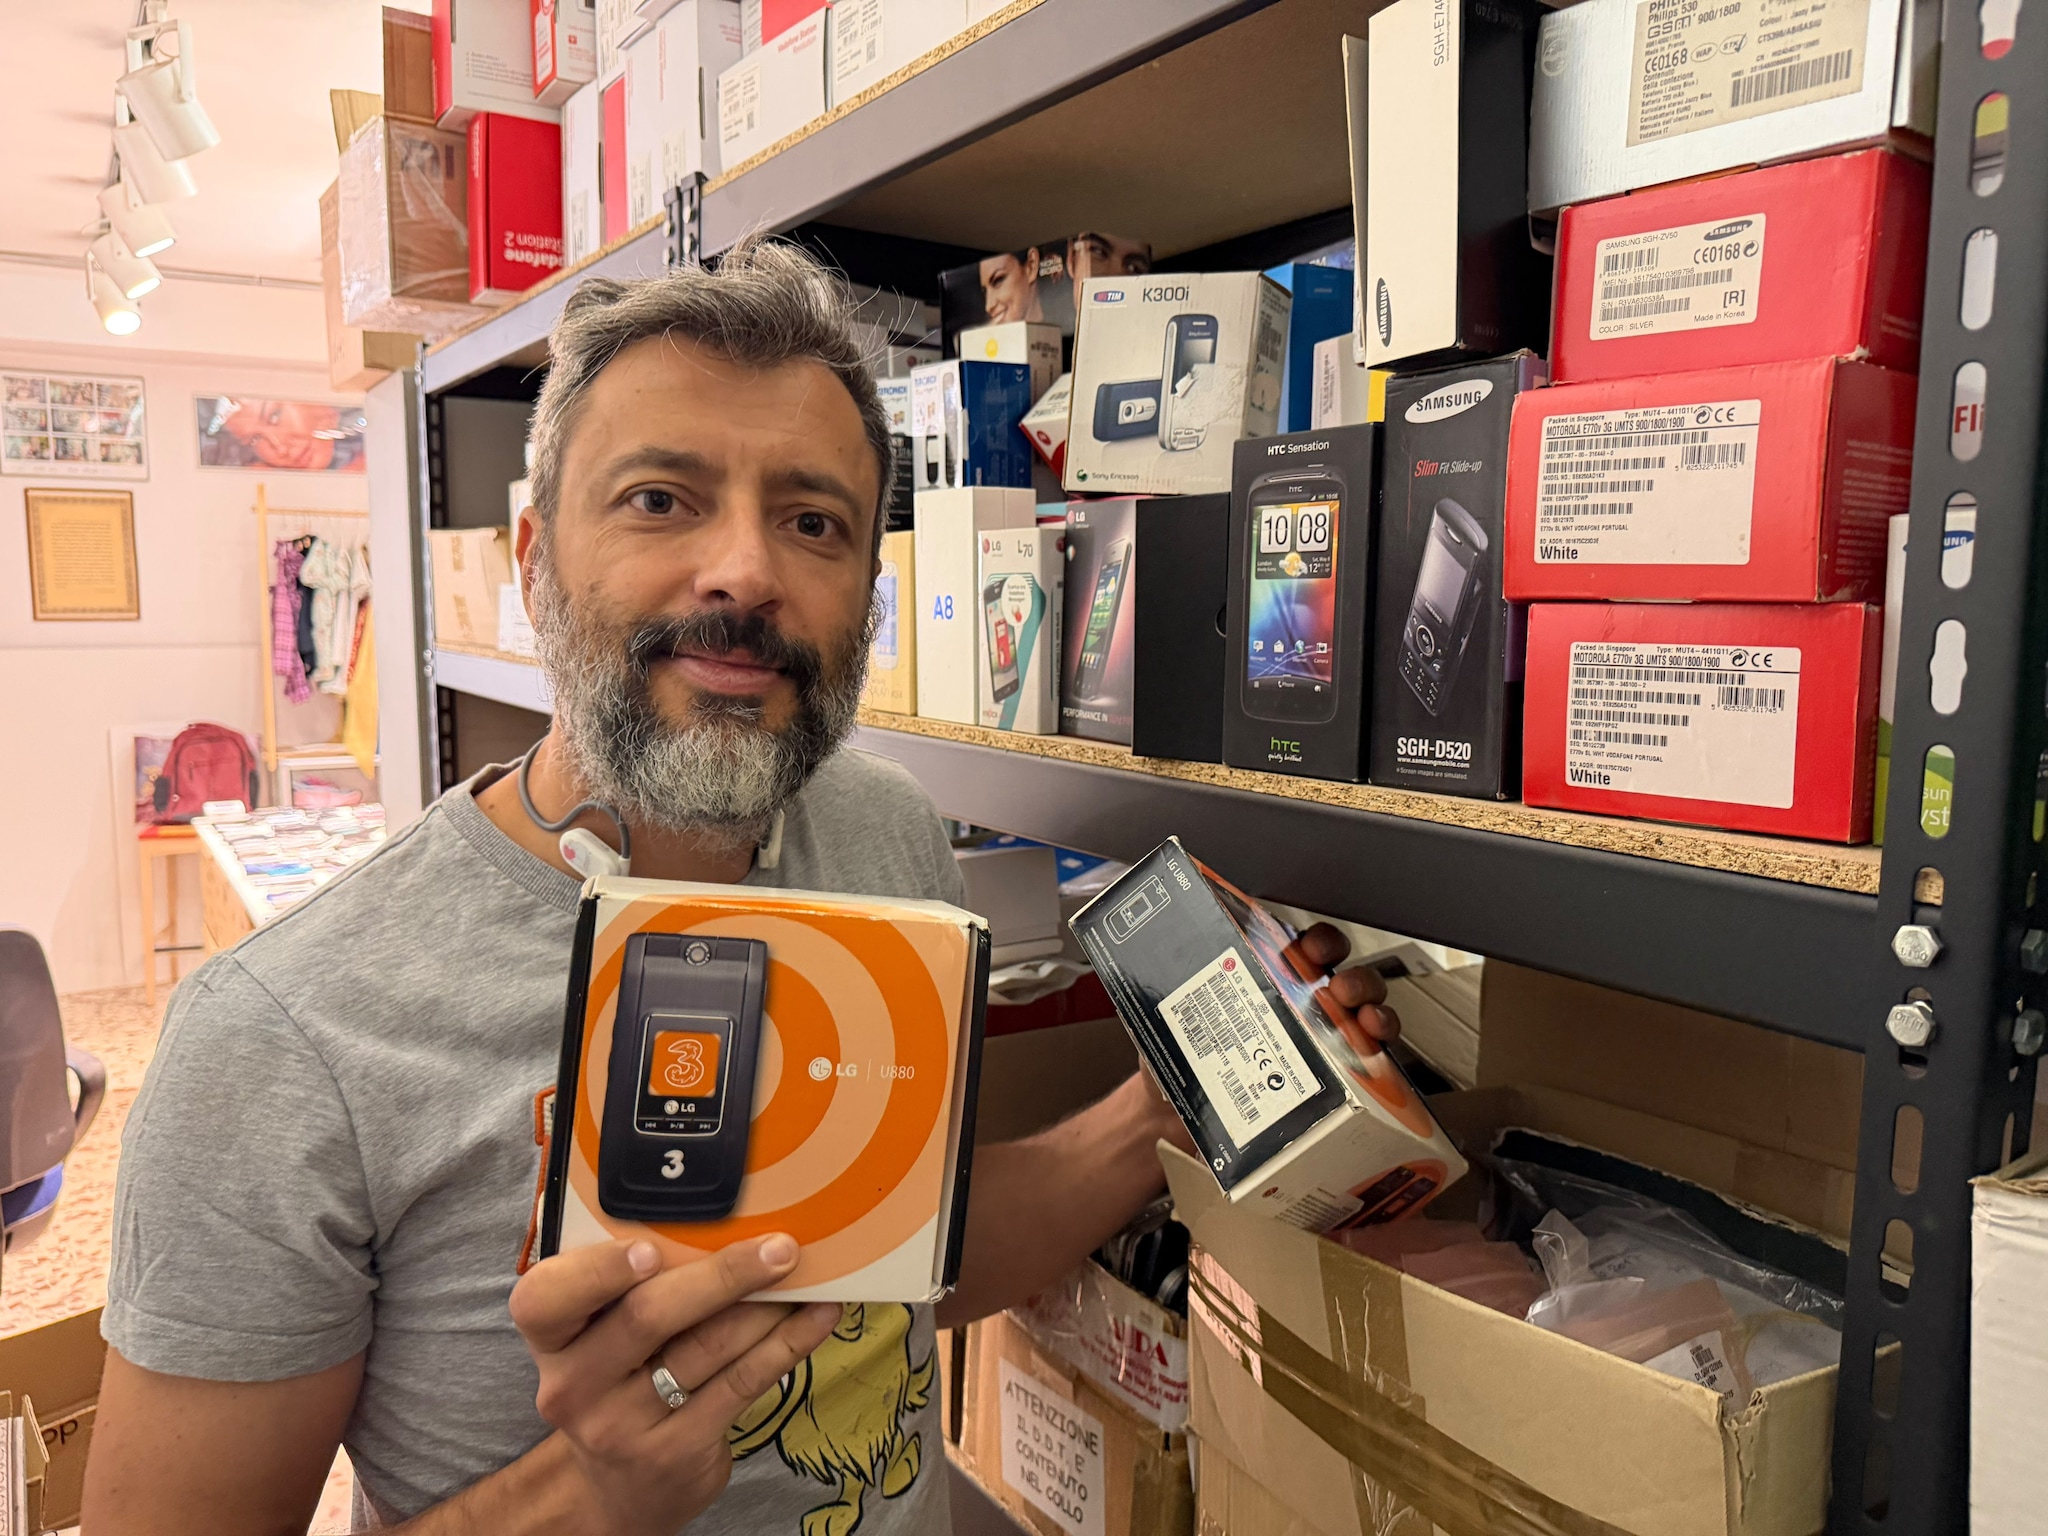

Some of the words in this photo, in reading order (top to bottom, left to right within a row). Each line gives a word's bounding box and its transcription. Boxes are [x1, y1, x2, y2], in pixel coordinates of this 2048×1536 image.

[1648, 7, 1678, 24] Philips
[1680, 0, 1697, 14] 530
[1697, 2, 1740, 24] 900/1800
[1695, 46, 1712, 58] WAP
[1642, 79, 1658, 90] della
[1660, 70, 1693, 86] confezione
[1643, 67, 1674, 82] Contenuto
[1709, 224, 1748, 236] SAMSUNG
[504, 231, 515, 247] 2
[1605, 237, 1640, 249] SAMSUNG
[1642, 231, 1677, 243] SGH-ZV50
[503, 248, 565, 270] odafone
[1107, 292, 1123, 300] TIM
[1142, 286, 1191, 303] K300i
[1693, 313, 1713, 321] Made
[1724, 310, 1744, 318] Korea
[1598, 324, 1623, 333] COLOR
[1629, 320, 1653, 329] SILVER
[1416, 391, 1482, 412] SAMSUNG
[1576, 414, 1604, 423] Singapore
[1624, 411, 1640, 419] Type:
[1546, 424, 1580, 436] MOTOROLA
[1583, 422, 1601, 433] E770v
[1602, 422, 1612, 432] 3G
[1614, 420, 1634, 431] UMTS
[1635, 416, 1685, 430] 900/1800/1900
[1267, 444, 1286, 456] HTC
[1287, 440, 1330, 454] Sensation
[1092, 472, 1109, 481] Sony
[1110, 472, 1139, 481] Ericsson
[1414, 459, 1439, 478] Slim
[1439, 461, 1450, 475] Fit
[1450, 460, 1483, 474] Slide-up
[1075, 512, 1085, 522] LG
[1264, 515, 1288, 545] 10
[1300, 512, 1327, 544] 08
[992, 541, 1002, 551] LG
[1018, 540, 1033, 557] L70
[1539, 546, 1578, 559] White
[933, 595, 954, 620] A8
[1573, 652, 1610, 663] MOTOROLA
[1612, 653, 1632, 663] E770v
[1634, 654, 1643, 664] 3G
[1646, 654, 1666, 665] UMTS
[1668, 655, 1720, 667] 900/1800/1900
[1063, 707, 1100, 722] PERFORMANCE
[1396, 736, 1472, 761] SGH-D520
[1397, 756, 1470, 769] www.samsungmobile.com
[1634, 754, 1663, 762] PORTUGAL
[1417, 768, 1434, 777] images
[1570, 768, 1610, 785] White
[1166, 858, 1178, 873] LG
[1172, 867, 1192, 892] U880
[1231, 970, 1243, 984] LG
[1199, 982, 1215, 1004] Product
[1211, 1002, 1224, 1018] Code:
[662, 1038, 705, 1088] 3
[835, 1064, 857, 1078] LG
[880, 1065, 915, 1080] U880
[1278, 1055, 1291, 1071] MADE
[1291, 1075, 1306, 1094] KOREA
[1247, 1082, 1262, 1101] Silver
[681, 1103, 696, 1113] LG
[661, 1149, 685, 1179] 3
[1005, 1380, 1098, 1455] ATTENZIONE
[1016, 1440, 1088, 1501] CONTENUTO
[1021, 1467, 1043, 1493] NEL
[1046, 1486, 1083, 1524] COLLO
